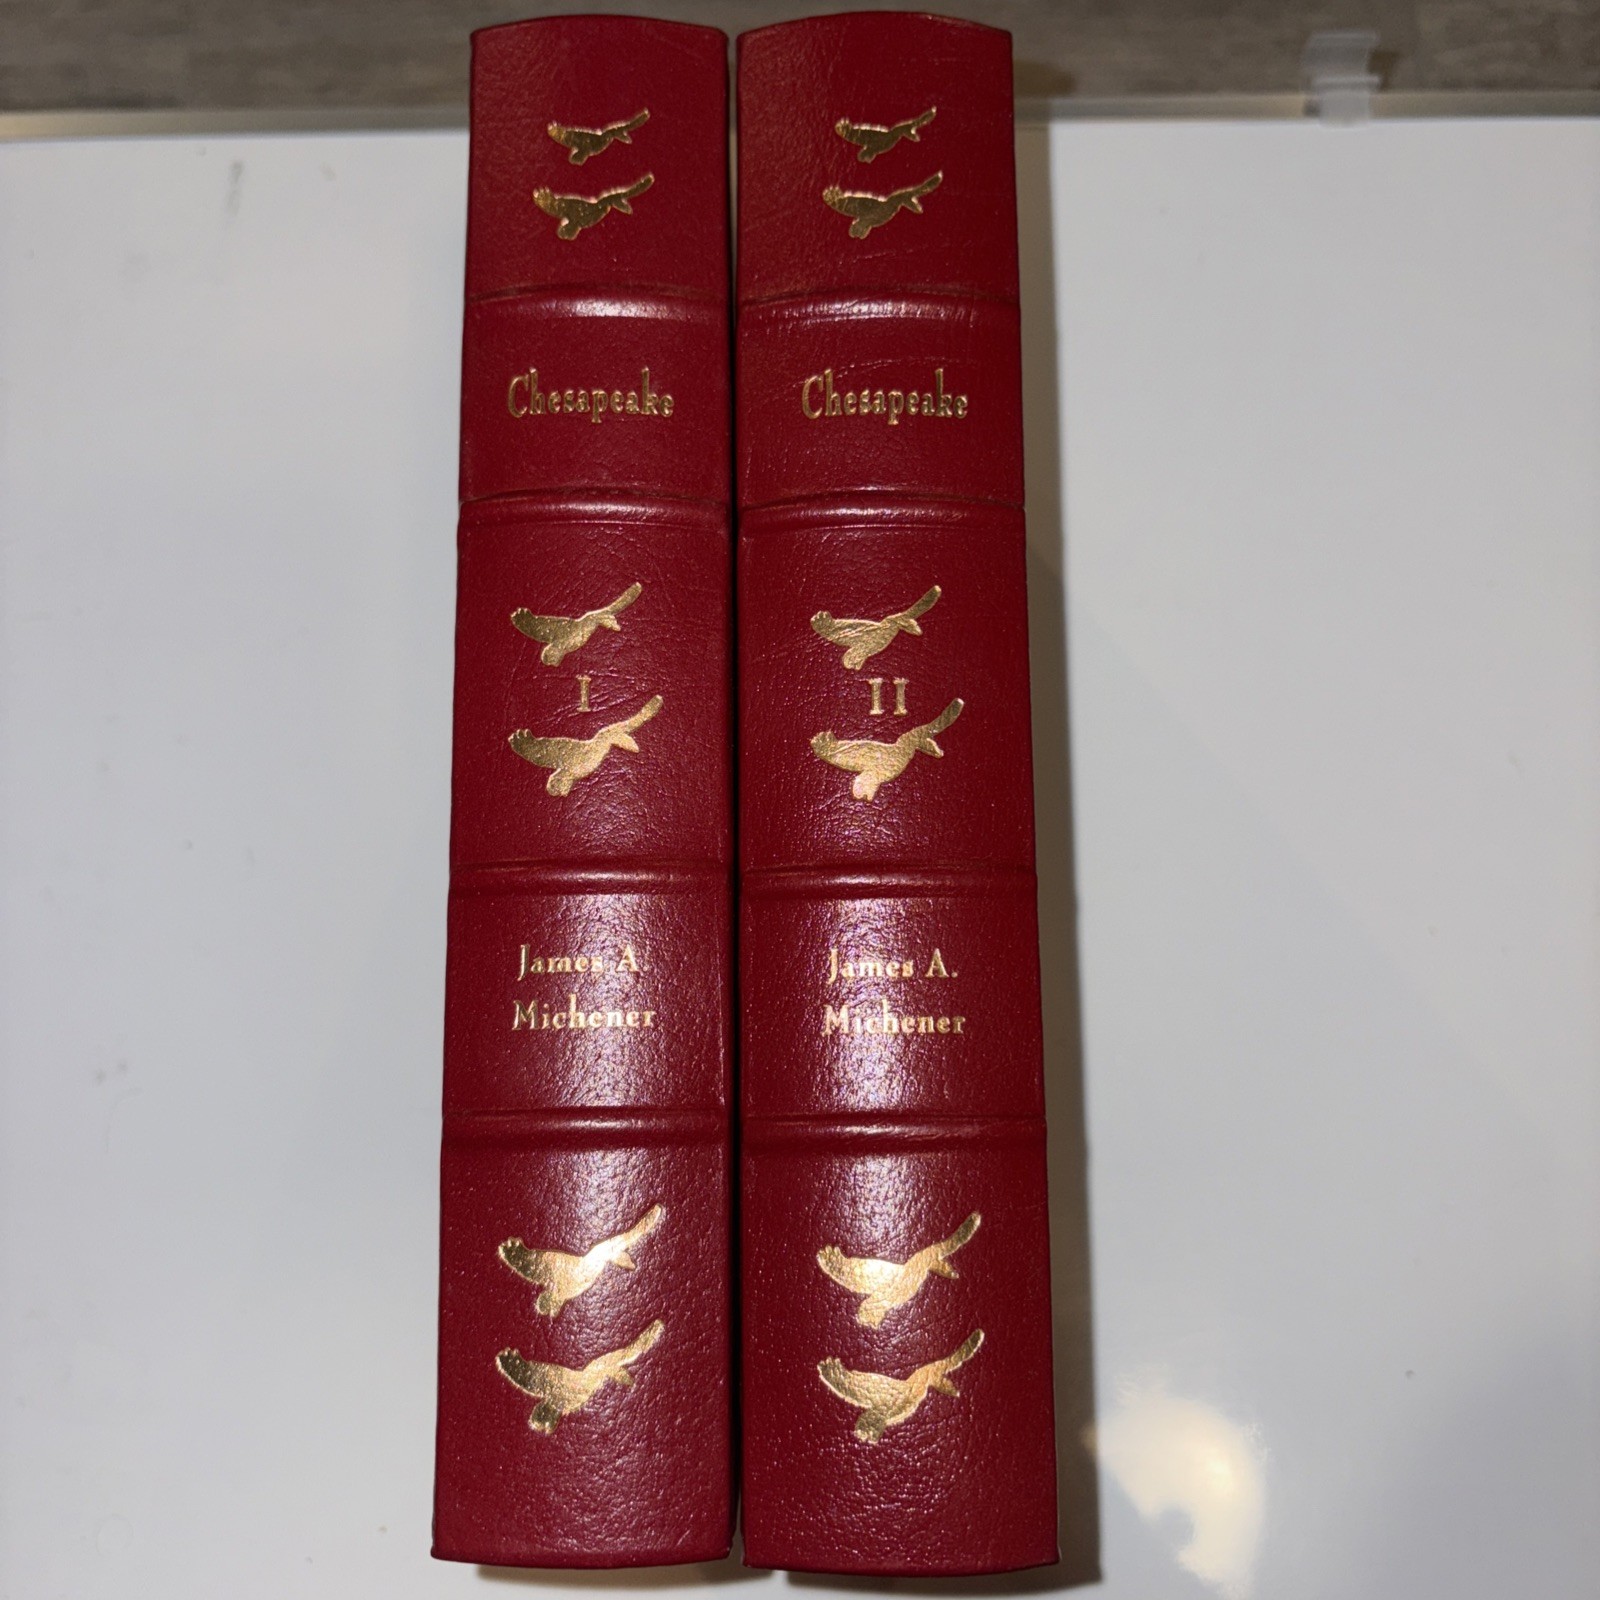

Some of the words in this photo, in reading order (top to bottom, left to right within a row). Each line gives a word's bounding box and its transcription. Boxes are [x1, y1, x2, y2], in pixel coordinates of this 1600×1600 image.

[507, 366, 675, 424] Chesapeake
[801, 367, 969, 425] Chesapeake
[576, 674, 592, 712] I
[868, 677, 908, 715] II
[518, 943, 604, 982] James
[615, 944, 650, 973] A.
[828, 947, 914, 985] James
[925, 948, 958, 979] A.
[512, 994, 657, 1032] Michener
[821, 997, 966, 1037] Michener
